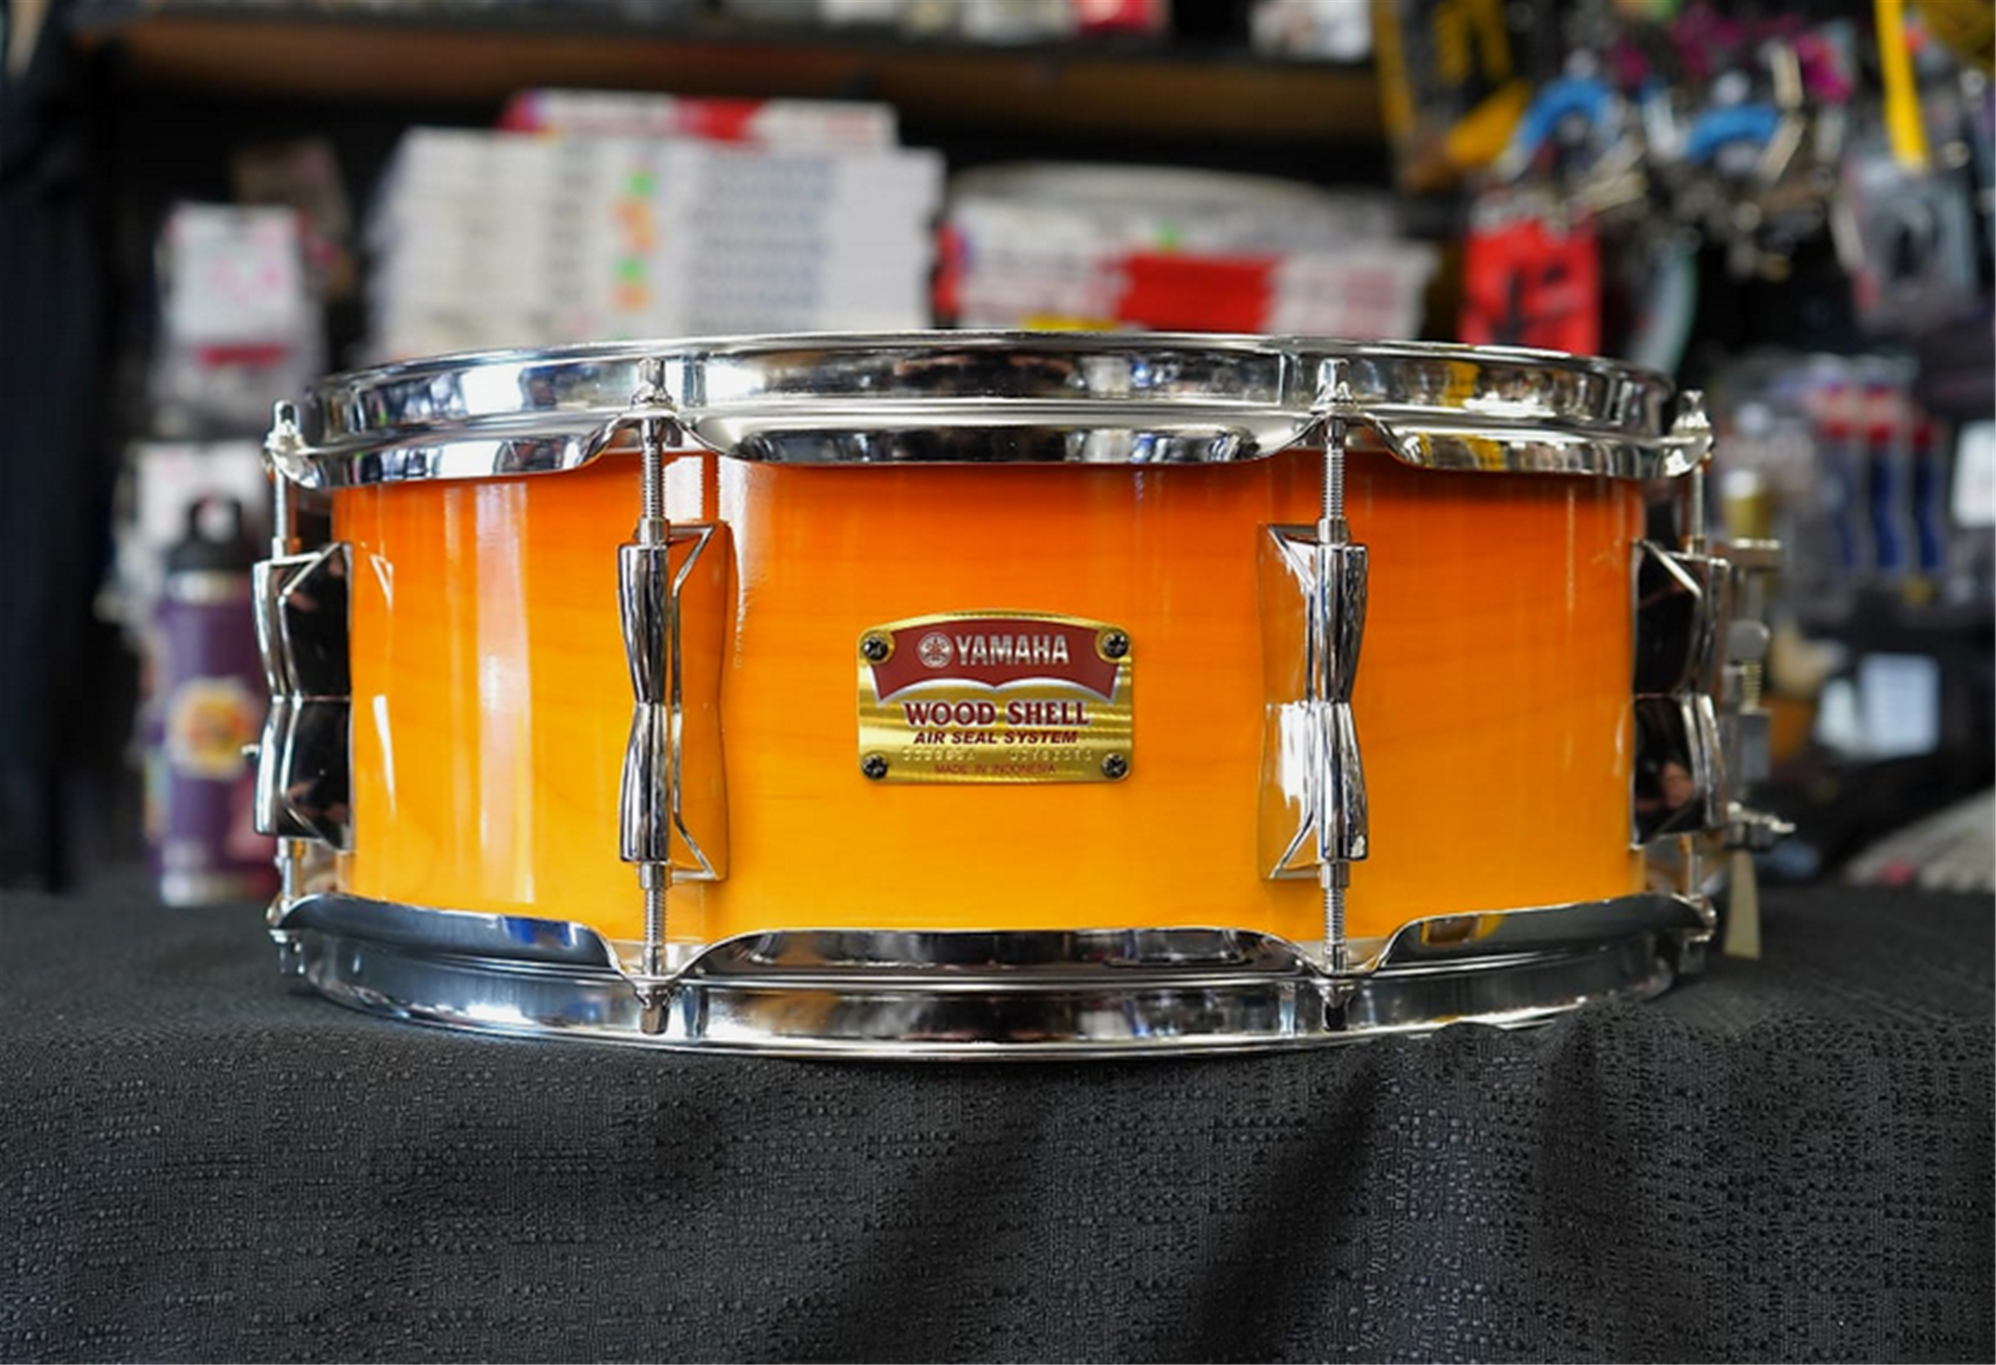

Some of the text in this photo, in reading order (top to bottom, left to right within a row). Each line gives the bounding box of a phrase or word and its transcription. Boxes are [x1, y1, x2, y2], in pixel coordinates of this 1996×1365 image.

[955, 634, 1070, 666] YAMAHA
[903, 701, 1090, 726] WOOD SHELL
[914, 731, 1078, 744] AIR SEAL SYSTEM
[934, 764, 967, 775] MADE
[975, 764, 988, 775] IN
